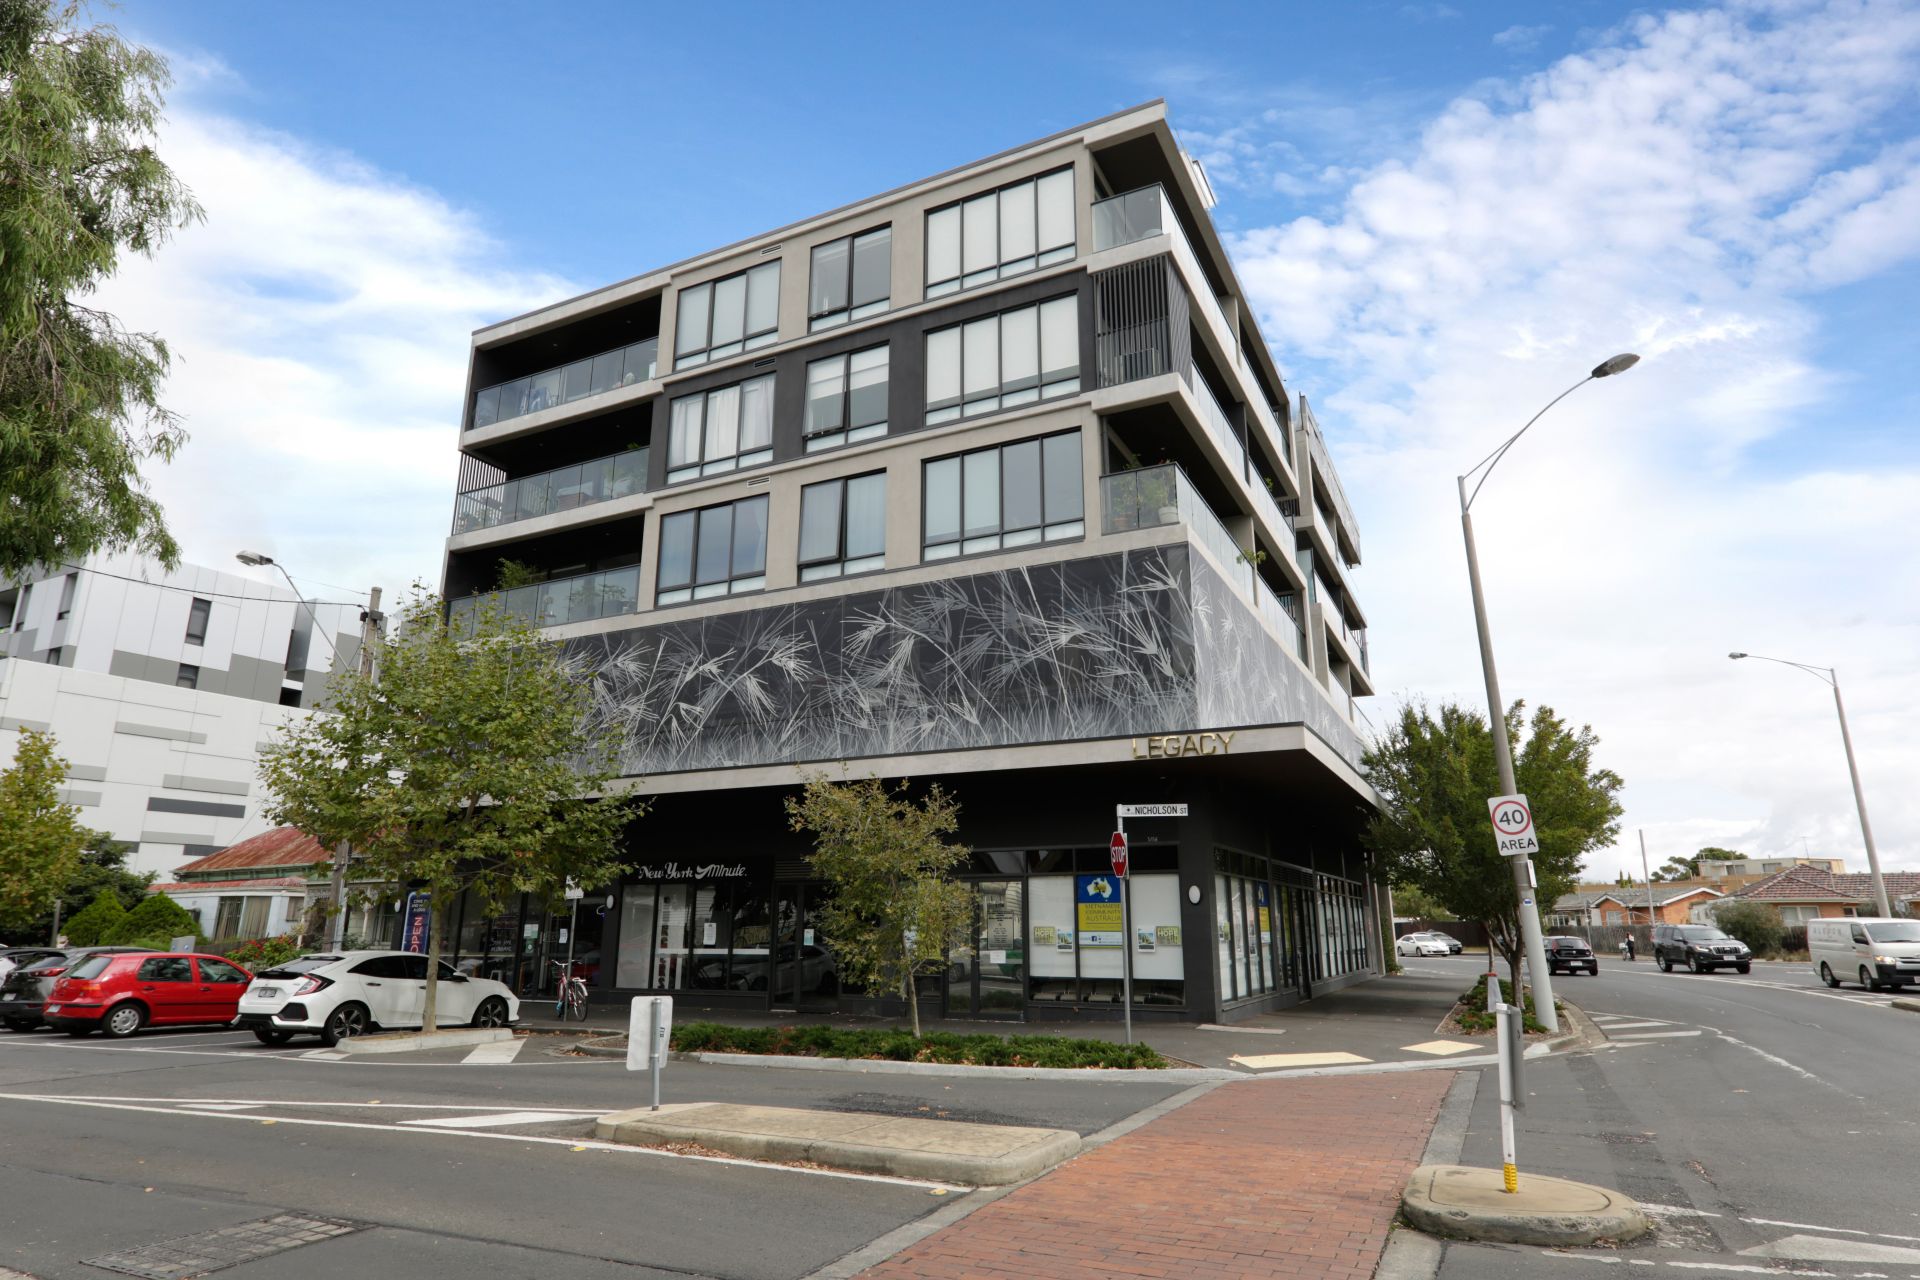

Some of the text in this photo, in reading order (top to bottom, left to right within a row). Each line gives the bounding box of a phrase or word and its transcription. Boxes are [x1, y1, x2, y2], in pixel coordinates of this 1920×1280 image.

[1132, 732, 1236, 759] LEGACY
[1134, 805, 1178, 815] NICHOLSON
[1499, 809, 1525, 826] 40
[1500, 838, 1536, 852] AREA
[1111, 846, 1126, 863] STOP
[638, 865, 664, 879] New
[664, 862, 693, 879] York
[411, 916, 424, 952] OPEN
